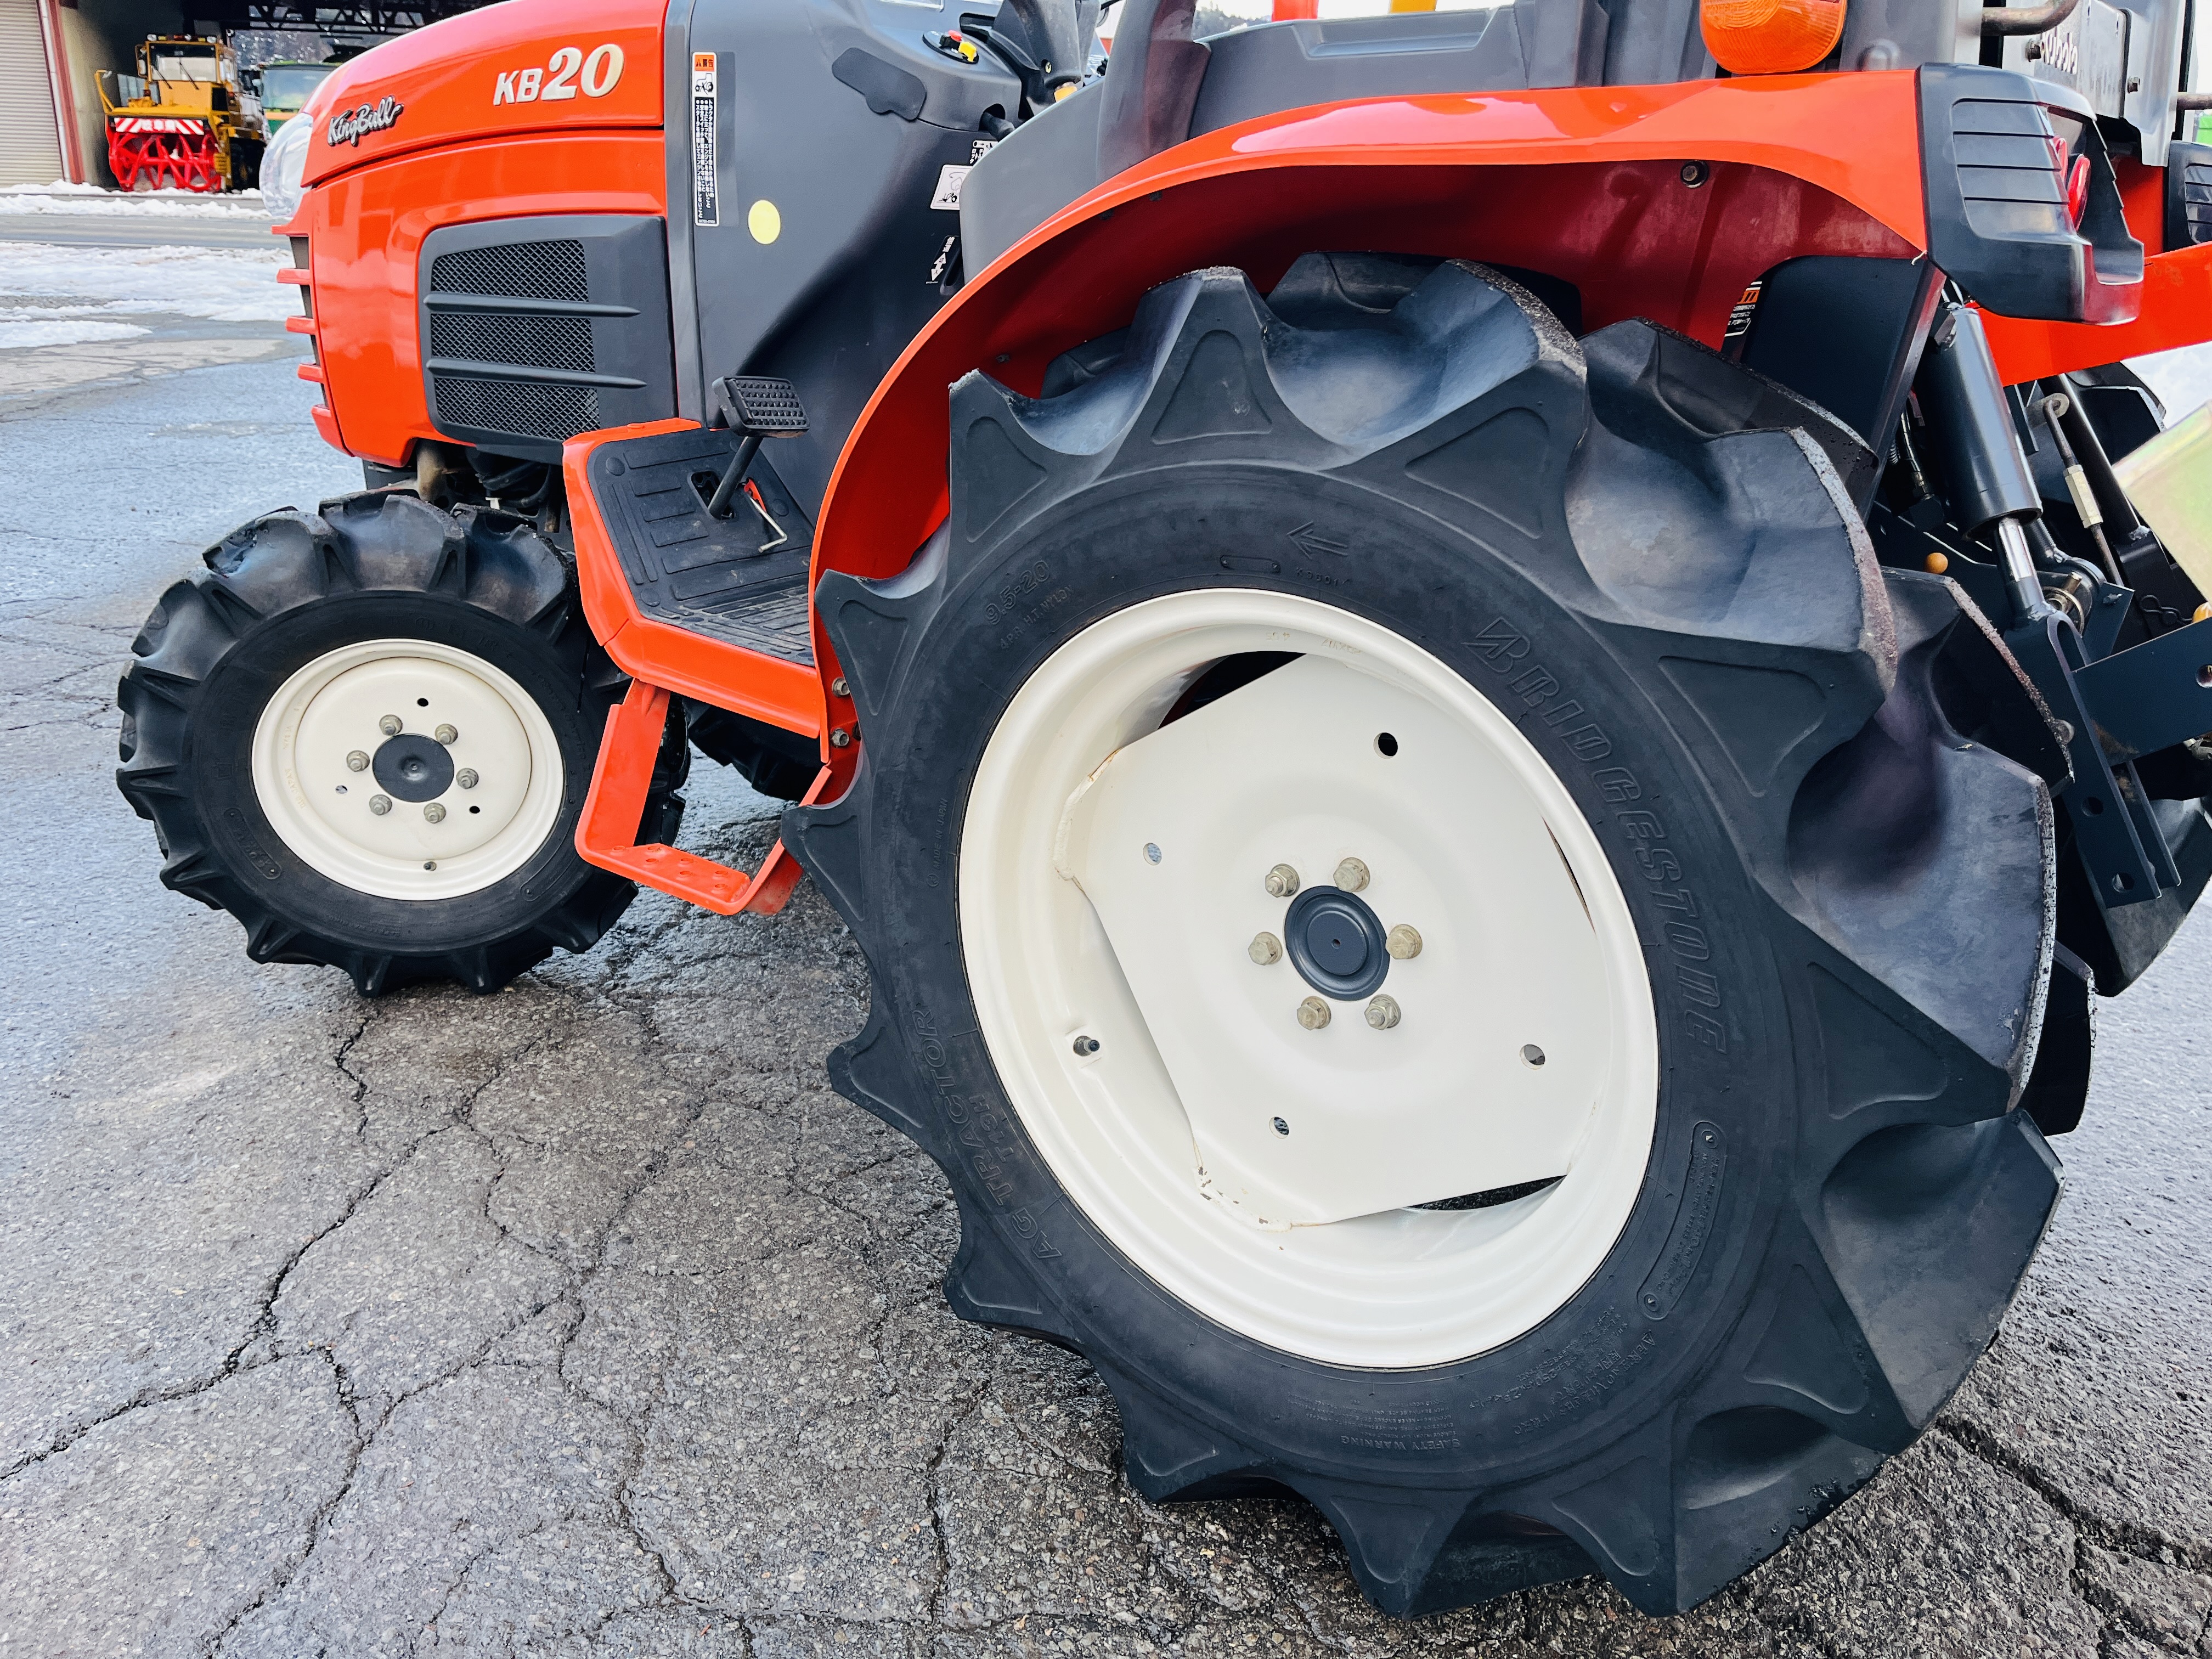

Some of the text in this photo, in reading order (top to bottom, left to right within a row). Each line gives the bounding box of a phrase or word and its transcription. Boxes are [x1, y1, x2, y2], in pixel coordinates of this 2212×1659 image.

[493, 43, 625, 106] KB20
[327, 95, 404, 147] KingBull
[984, 558, 1051, 626] 9.5-20
[1040, 583, 1075, 613] NYLON
[1462, 616, 1728, 1054] BRIDGESTONE
[911, 1008, 1063, 1262] AG TRACTOR
[1339, 1434, 1462, 1451] SAFETY WARNING
